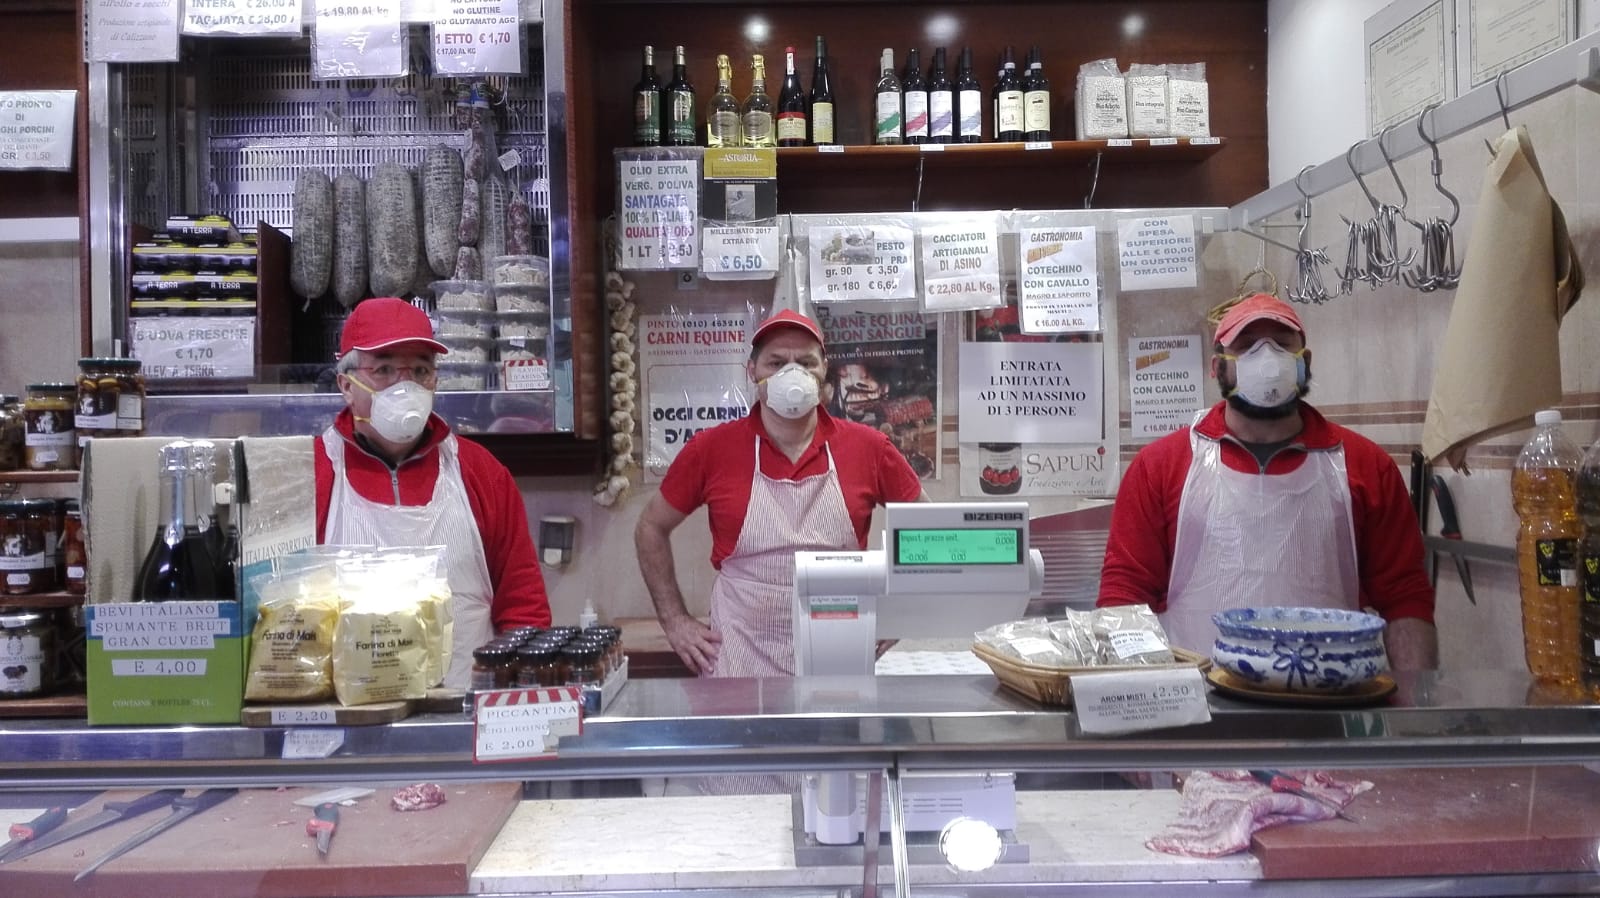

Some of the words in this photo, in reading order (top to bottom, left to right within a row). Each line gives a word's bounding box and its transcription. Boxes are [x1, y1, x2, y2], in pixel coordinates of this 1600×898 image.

[436, 34, 441, 44] 1
[445, 33, 473, 44] ETTO
[479, 33, 486, 43] €
[489, 32, 511, 45] 1,70
[15, 100, 52, 109] PRONTO
[15, 113, 25, 121] DI
[20, 126, 55, 134] PORCINI
[630, 166, 652, 175] OLIO
[657, 166, 688, 175] EXTRA
[625, 182, 653, 191] VERG.
[658, 180, 694, 190] D'OLIVA
[625, 194, 688, 209] SANTAGATA
[625, 210, 649, 224] 100%
[652, 210, 694, 223] ITALIANO
[1143, 219, 1169, 227] CON
[933, 233, 986, 244] CACCIATORI
[1030, 231, 1083, 243] GASTRONOMIA
[1138, 229, 1175, 237] SPESA
[876, 242, 905, 250] PESTO
[1126, 237, 1192, 248] SUPERIORE
[628, 246, 634, 257] 1
[638, 245, 652, 257] LT
[932, 246, 989, 258] ARTIGIANALI
[1121, 250, 1150, 258] ALLE
[733, 255, 762, 271] 6,50
[940, 261, 949, 271] DI
[954, 257, 982, 270] ASINO
[840, 267, 852, 275] 90
[878, 265, 899, 276] 3,50
[1027, 264, 1082, 275] COTECHINO
[1133, 266, 1188, 276] OMAGGIO
[842, 282, 860, 291] 180
[869, 281, 875, 290] €
[929, 286, 934, 295] €
[937, 284, 962, 295] 22,80
[964, 283, 977, 292] AL
[1024, 280, 1044, 289] CON
[1047, 278, 1090, 288] CAVALLO
[870, 312, 924, 327] EQUINA
[150, 331, 182, 341] UOVA
[647, 331, 690, 344] CARNI
[694, 329, 745, 345] EQUINE
[867, 326, 923, 340] SANGUE
[1139, 341, 1189, 350] GASTRONOMIA
[176, 349, 183, 358] €
[187, 348, 214, 361] 1,70
[1000, 361, 1062, 371] ENTRATA
[990, 376, 1071, 386] LIMITATATA
[1136, 371, 1189, 381] COTECHINO
[1155, 384, 1196, 393] CAVALLO
[978, 391, 996, 401] AD
[1000, 391, 1019, 401] UN
[1022, 391, 1086, 401] MASSIMO
[653, 407, 693, 421] OGGI
[988, 406, 1001, 416] DI
[1005, 406, 1011, 416] 3
[1016, 406, 1077, 417] PERSONE
[963, 513, 1023, 521] BIZERBA
[246, 544, 277, 564] ITALIAN
[99, 608, 131, 617] BEVI
[141, 605, 215, 617] ITALIANO
[96, 621, 177, 632] SPUMANTE
[186, 620, 227, 631] BRUT
[108, 637, 150, 647] GRAN
[158, 636, 209, 645] CUVEE
[356, 642, 385, 651] Farina
[388, 640, 396, 648] di
[134, 661, 145, 672] E
[1101, 695, 1124, 703] AROMI
[1126, 692, 1146, 701] MISTI
[279, 711, 286, 720] E
[487, 706, 577, 718] PICCANTINA
